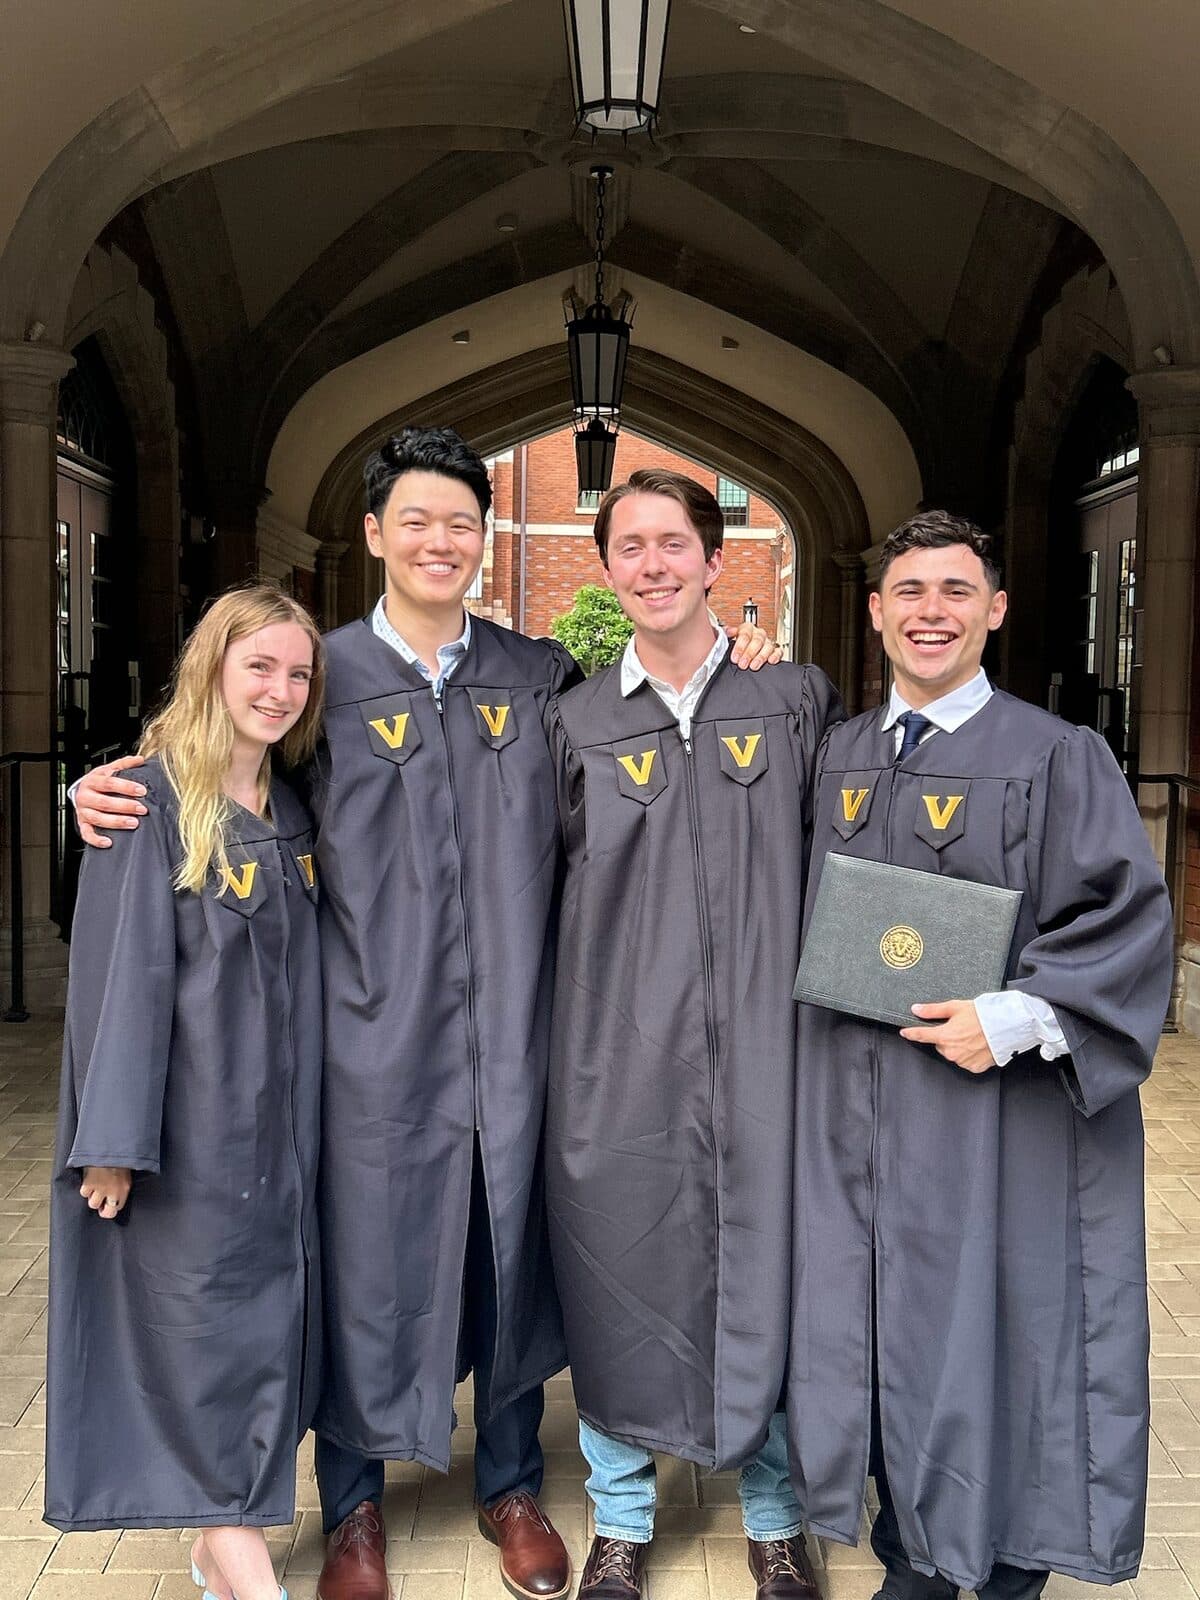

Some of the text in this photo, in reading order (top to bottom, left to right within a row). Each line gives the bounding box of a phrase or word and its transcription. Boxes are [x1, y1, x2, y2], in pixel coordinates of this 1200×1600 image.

[369, 712, 410, 749] V
[476, 704, 510, 737] V
[616, 750, 657, 785] V
[720, 734, 762, 768] V
[841, 788, 870, 822] V
[922, 795, 964, 830] V
[216, 862, 258, 900] V
